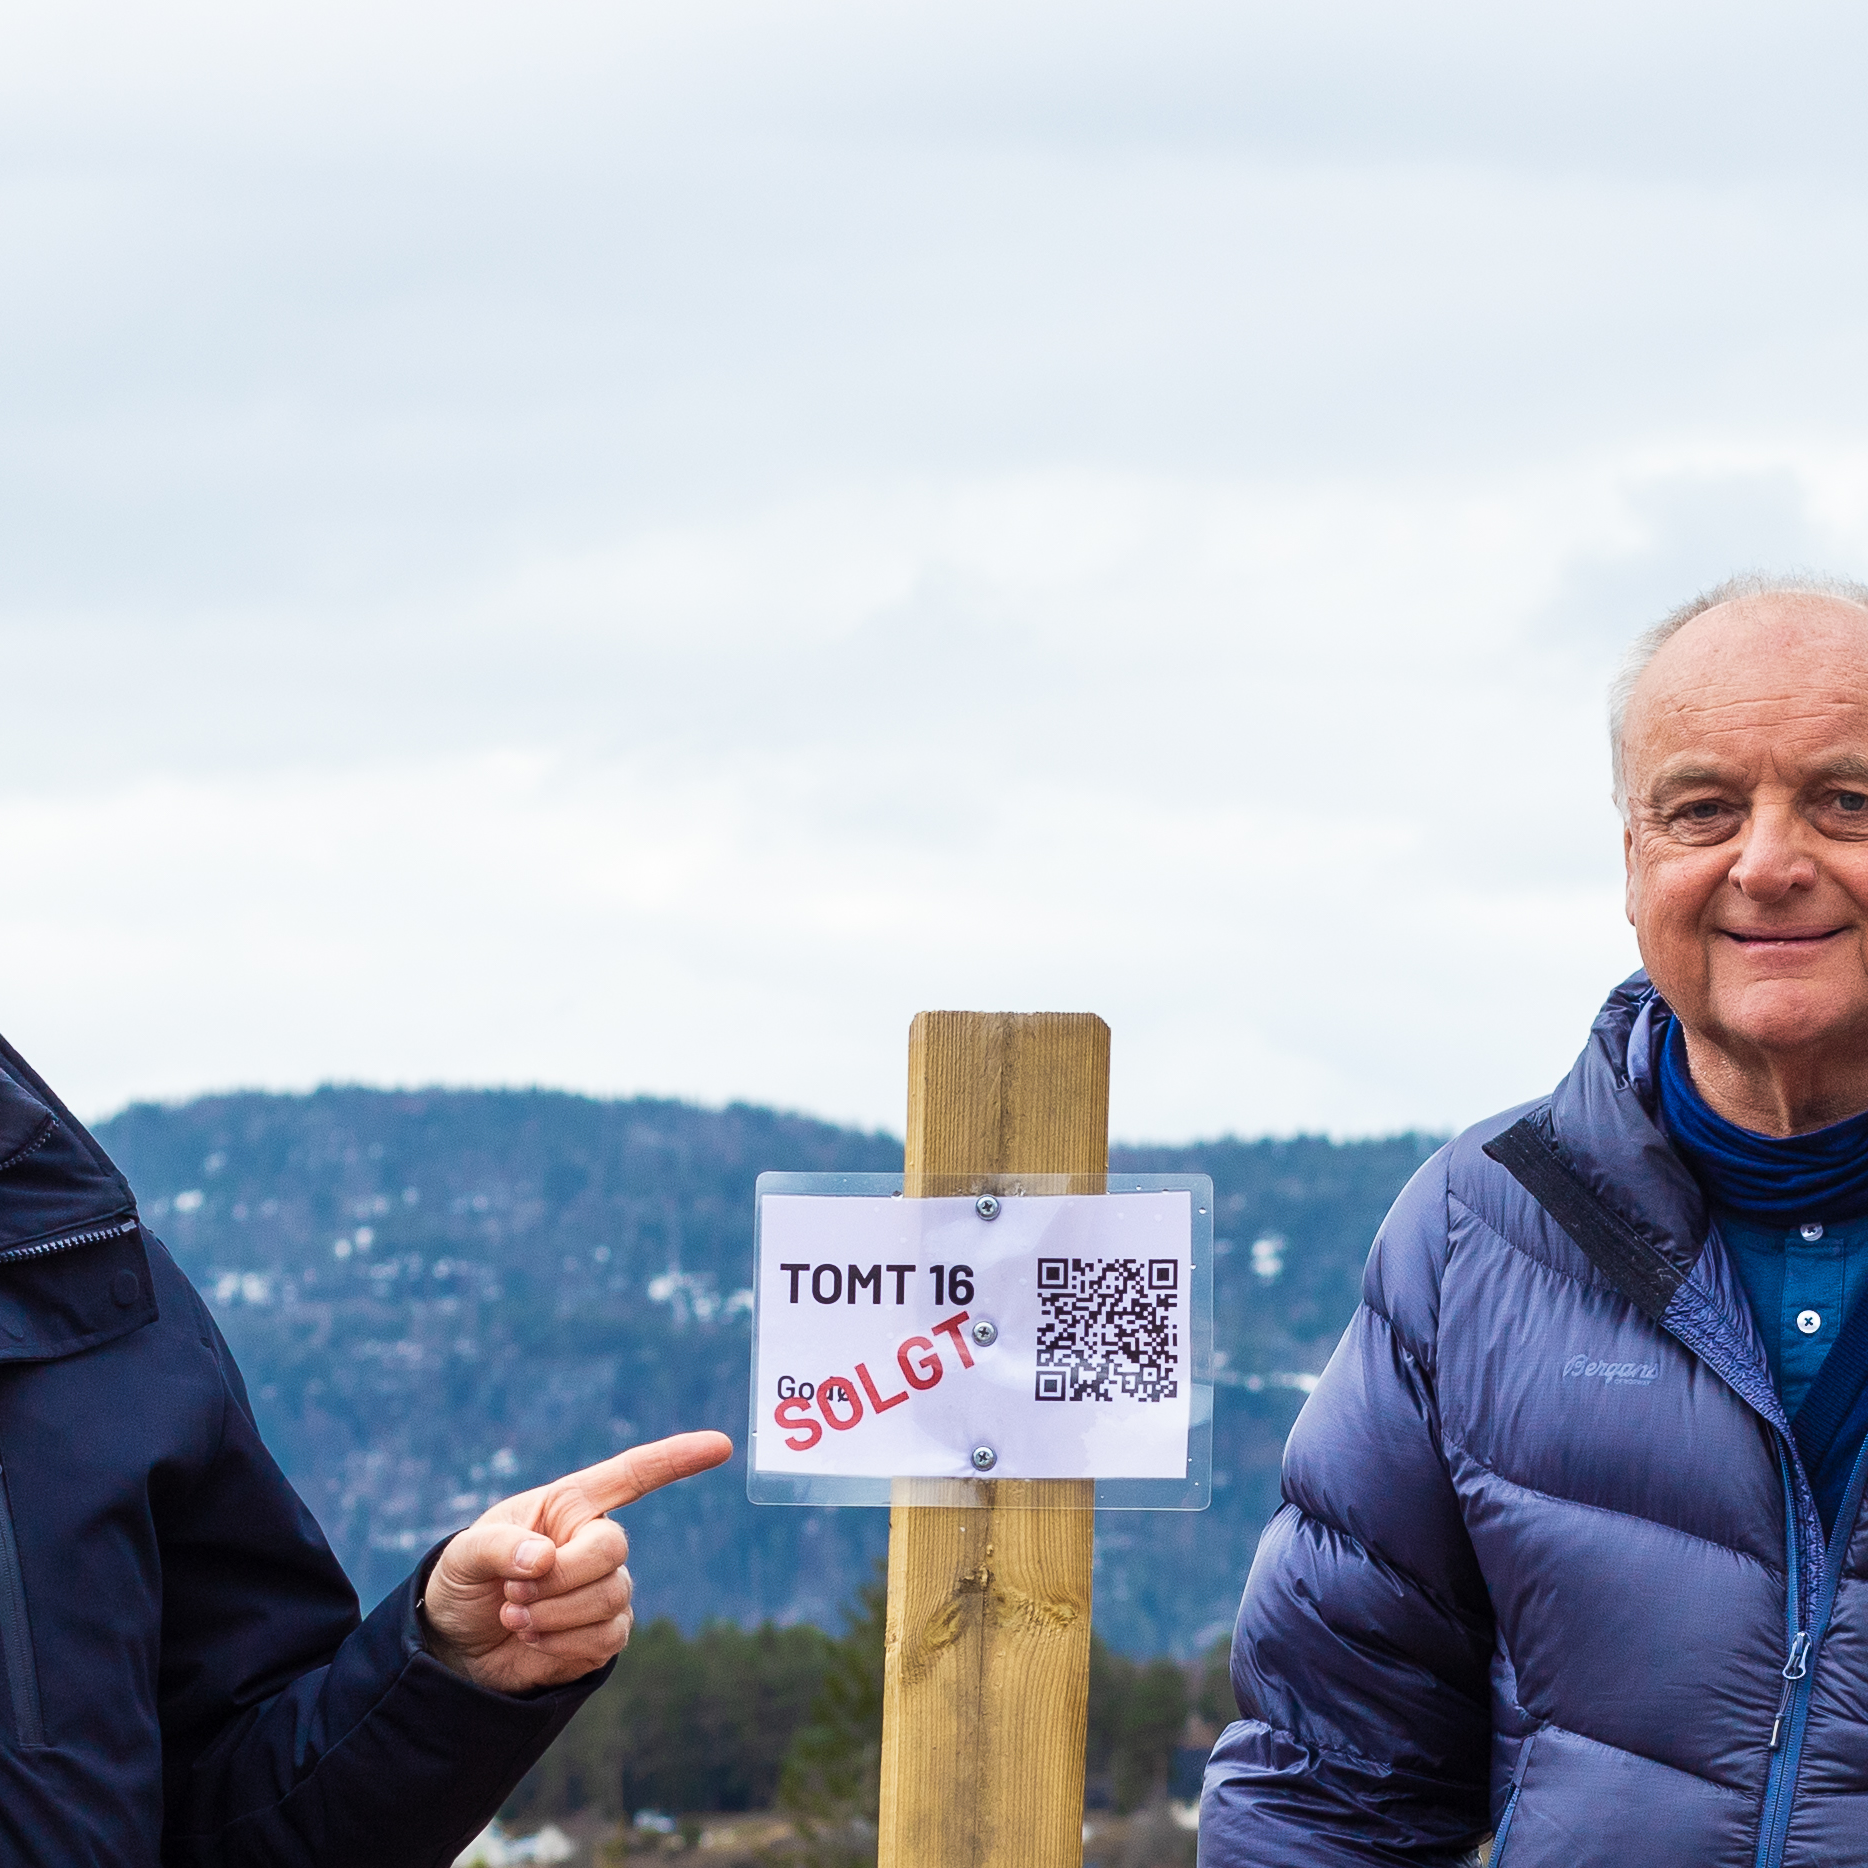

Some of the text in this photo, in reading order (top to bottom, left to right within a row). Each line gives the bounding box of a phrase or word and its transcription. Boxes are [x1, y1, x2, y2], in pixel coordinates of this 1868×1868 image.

[780, 1263, 975, 1306] TOMT 16
[774, 1310, 975, 1451] SOLGT
[1562, 1354, 1660, 1386] Bergans
